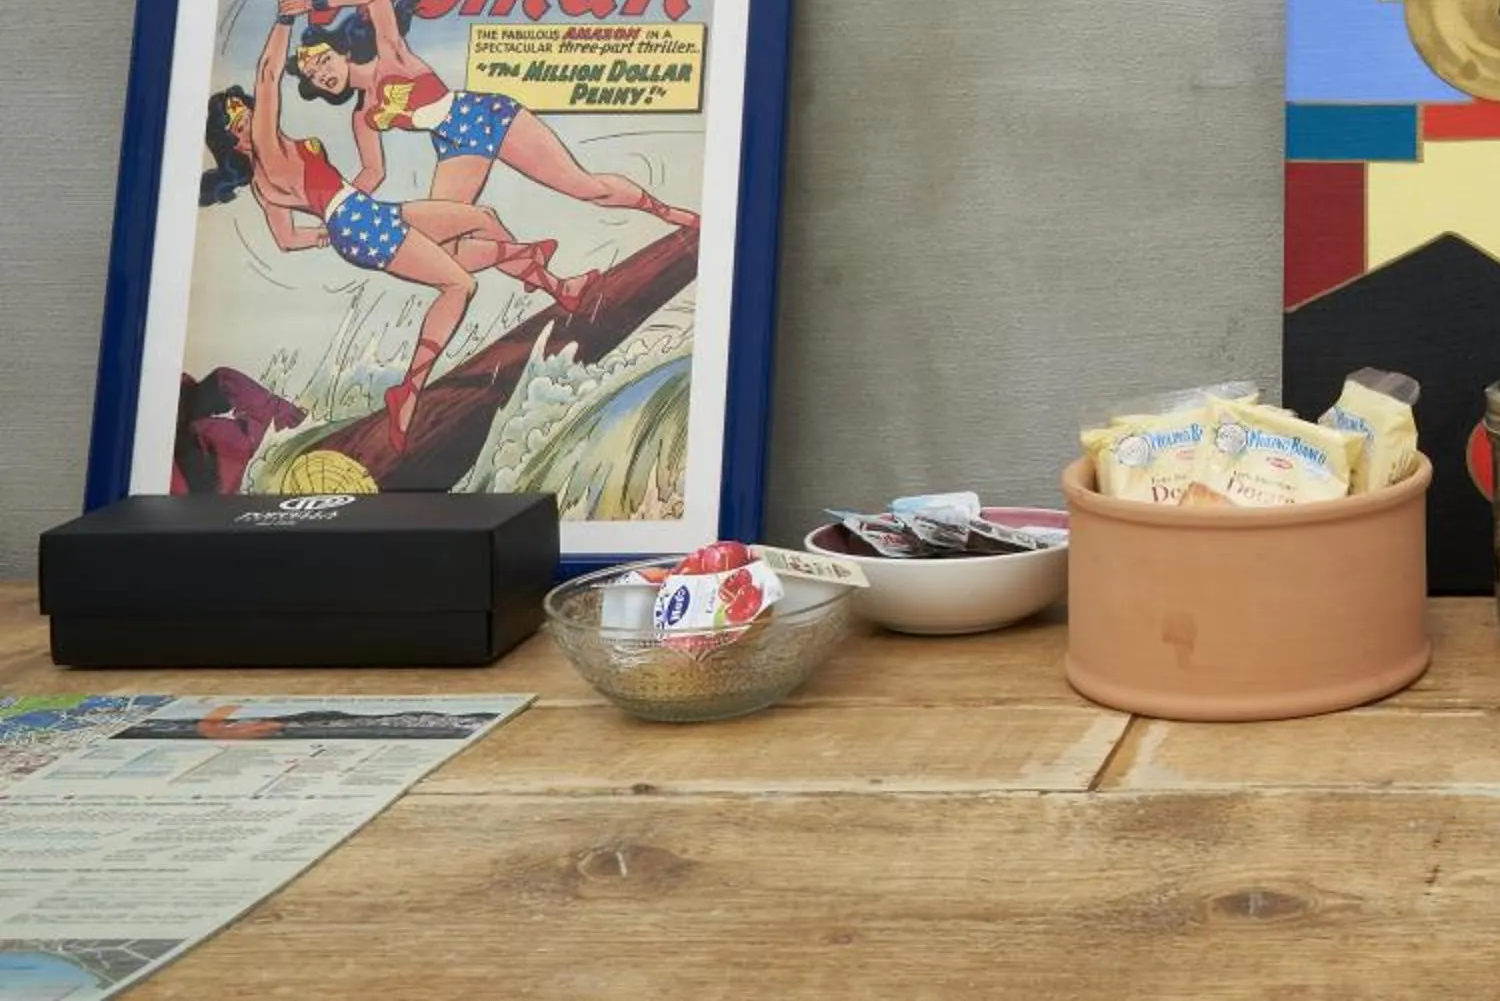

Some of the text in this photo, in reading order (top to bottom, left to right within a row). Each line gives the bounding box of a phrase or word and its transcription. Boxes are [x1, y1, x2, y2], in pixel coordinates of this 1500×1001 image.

[477, 26, 672, 41] THE FABULOUS AMAZON IN A
[474, 41, 553, 54] SPECTACULAR
[558, 40, 634, 56] three-part
[522, 59, 606, 82] MILLION
[606, 58, 693, 82] DOLLAR
